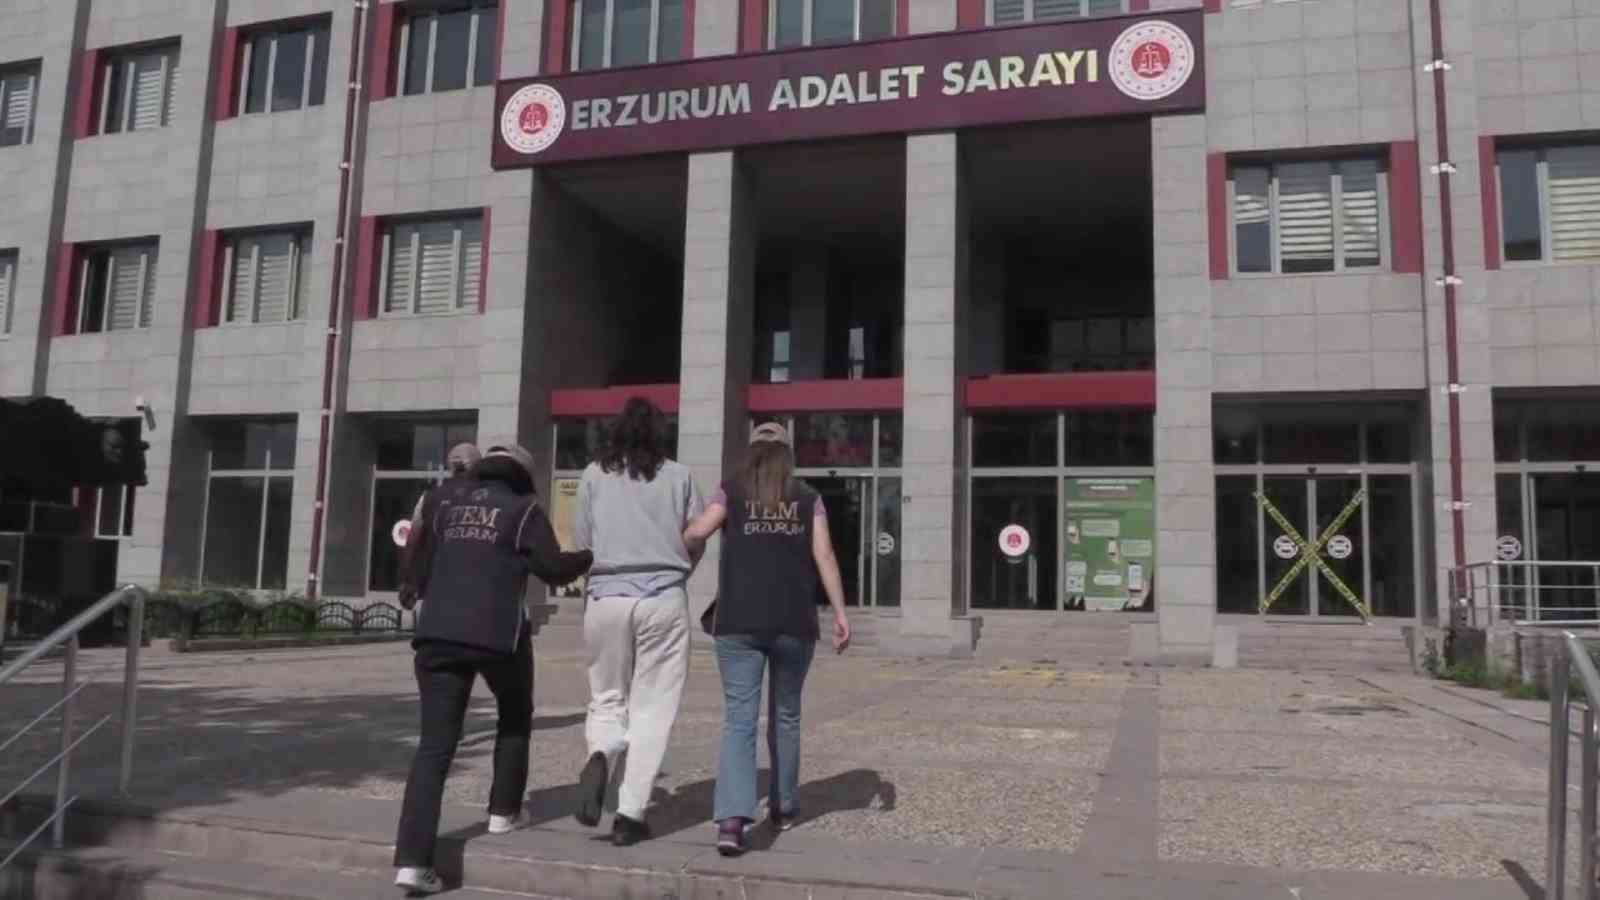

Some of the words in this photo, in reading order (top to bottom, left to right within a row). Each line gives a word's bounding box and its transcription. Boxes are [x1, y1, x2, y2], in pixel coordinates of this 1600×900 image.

[571, 82, 752, 130] ERZURUM
[768, 65, 925, 111] ADALET
[942, 50, 1098, 95] SARAYI
[448, 505, 501, 528] TEM
[745, 501, 800, 520] TEM
